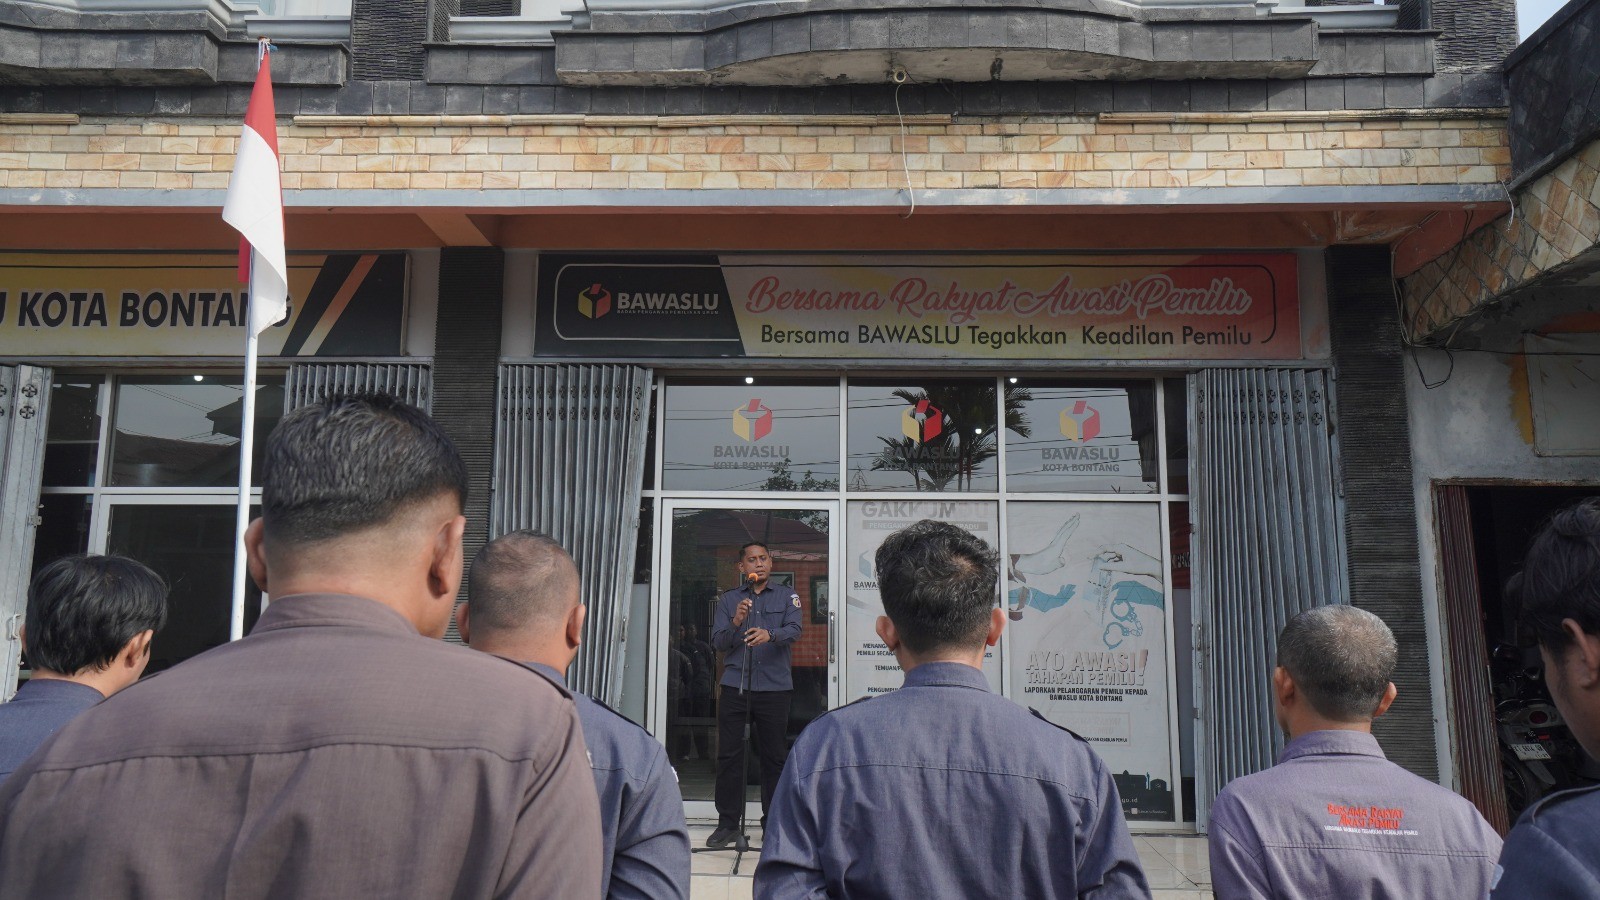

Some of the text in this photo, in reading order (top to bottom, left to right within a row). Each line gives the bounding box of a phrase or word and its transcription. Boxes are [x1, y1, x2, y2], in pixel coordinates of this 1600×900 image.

[617, 292, 719, 310] BAWASLU
[745, 273, 1252, 324] Bersama Rakyat Awasi Pemilu
[18, 291, 108, 328] KOTA
[761, 324, 1251, 350] Bersama BAWASLU Tegakkan Keadilan Pemilu
[713, 445, 790, 458] BAWASLU
[884, 446, 960, 459] BAWASLU
[1041, 447, 1120, 460] BAWASLU
[713, 461, 738, 470] KOTA
[1042, 463, 1120, 472] KOTA BONTANG
[1025, 649, 1065, 671] AYO
[1026, 671, 1136, 686] TAHAPAN PEMILU
[1024, 686, 1056, 694] LAPORKAN
[1057, 687, 1100, 695] PELANGGARAN
[1125, 688, 1148, 696] KEPADA
